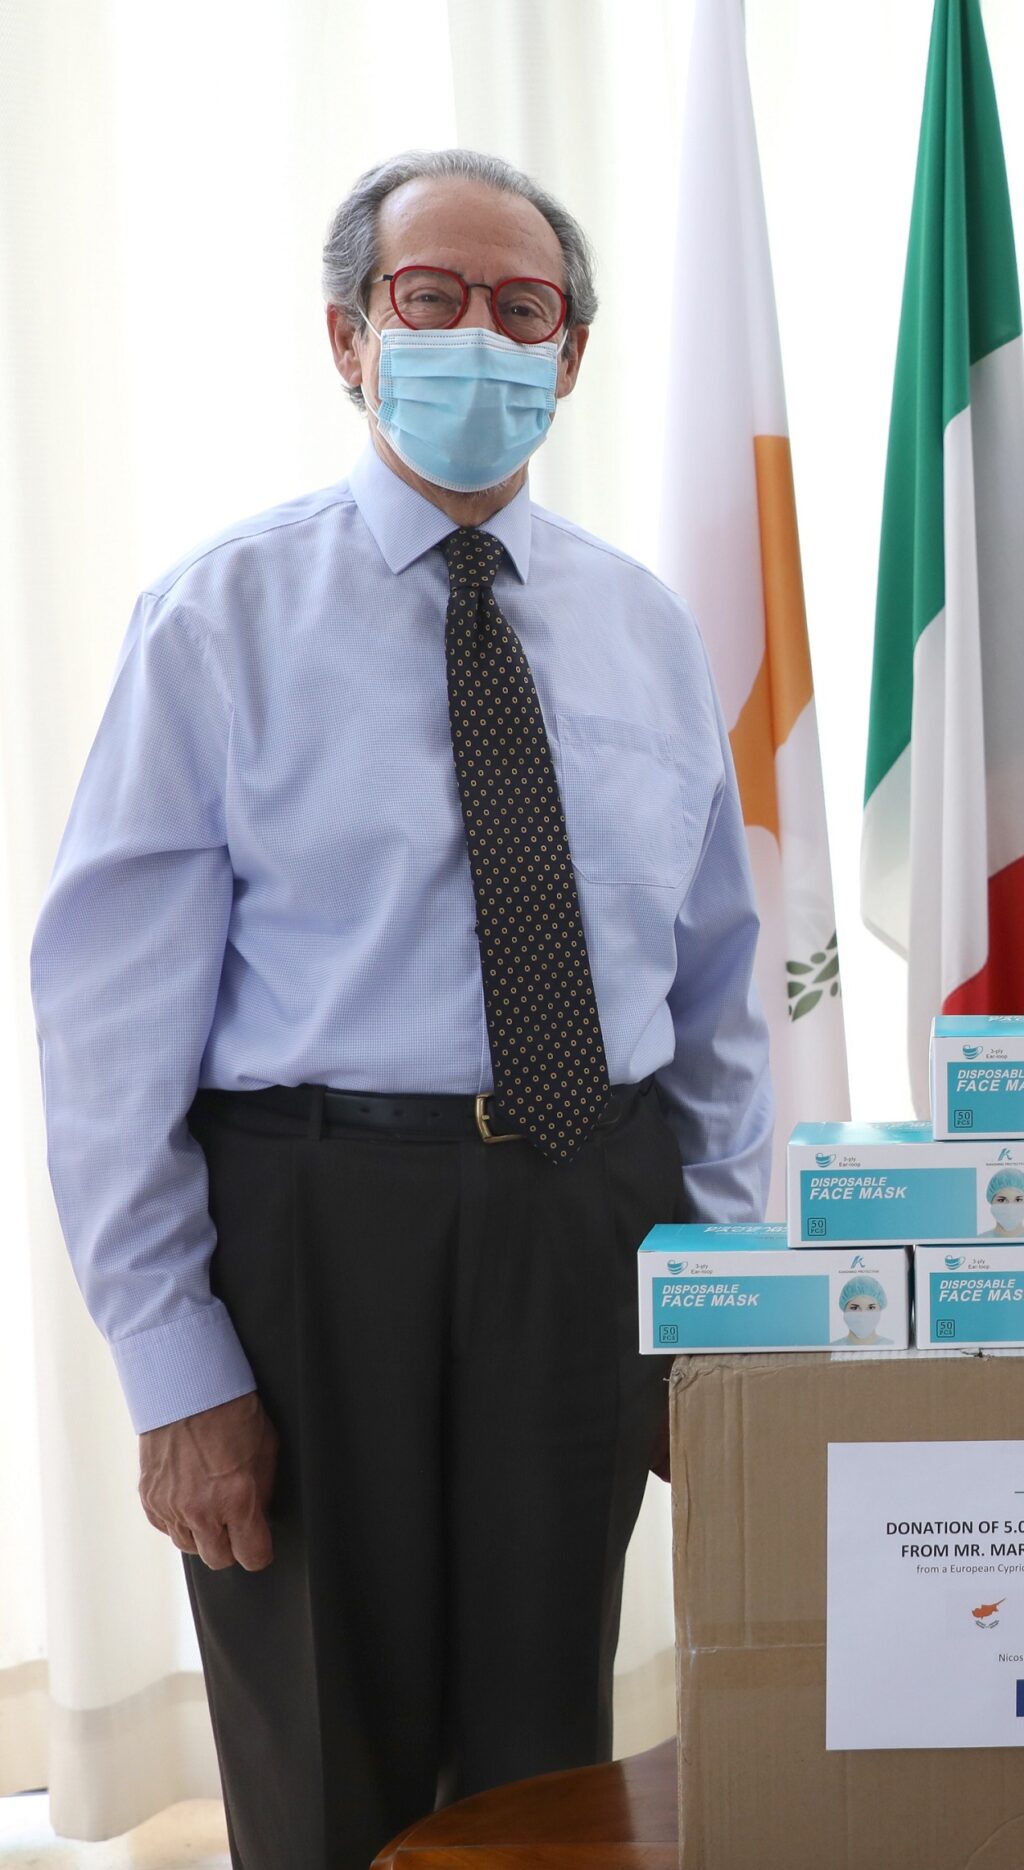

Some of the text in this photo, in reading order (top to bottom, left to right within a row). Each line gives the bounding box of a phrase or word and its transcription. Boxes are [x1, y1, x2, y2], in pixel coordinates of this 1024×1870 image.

[956, 1079, 1001, 1092] FACE
[958, 1112, 971, 1120] 50
[810, 1177, 887, 1187] DISPOSABLE
[809, 1186, 907, 1200] FACE MASK
[811, 1219, 824, 1228] 50
[662, 1284, 740, 1294] DISPOSABLE
[940, 1279, 1016, 1289] DISPOSABLE
[661, 1294, 760, 1307] FACE MASK
[939, 1290, 981, 1302] FACE
[663, 1326, 676, 1335] 50
[940, 1321, 953, 1330] 50
[886, 1521, 974, 1535] DONATION
[978, 1520, 999, 1534] OF
[901, 1544, 950, 1558] FROM
[954, 1544, 985, 1557] MR.
[916, 1564, 940, 1574] from
[950, 1563, 996, 1576] European
